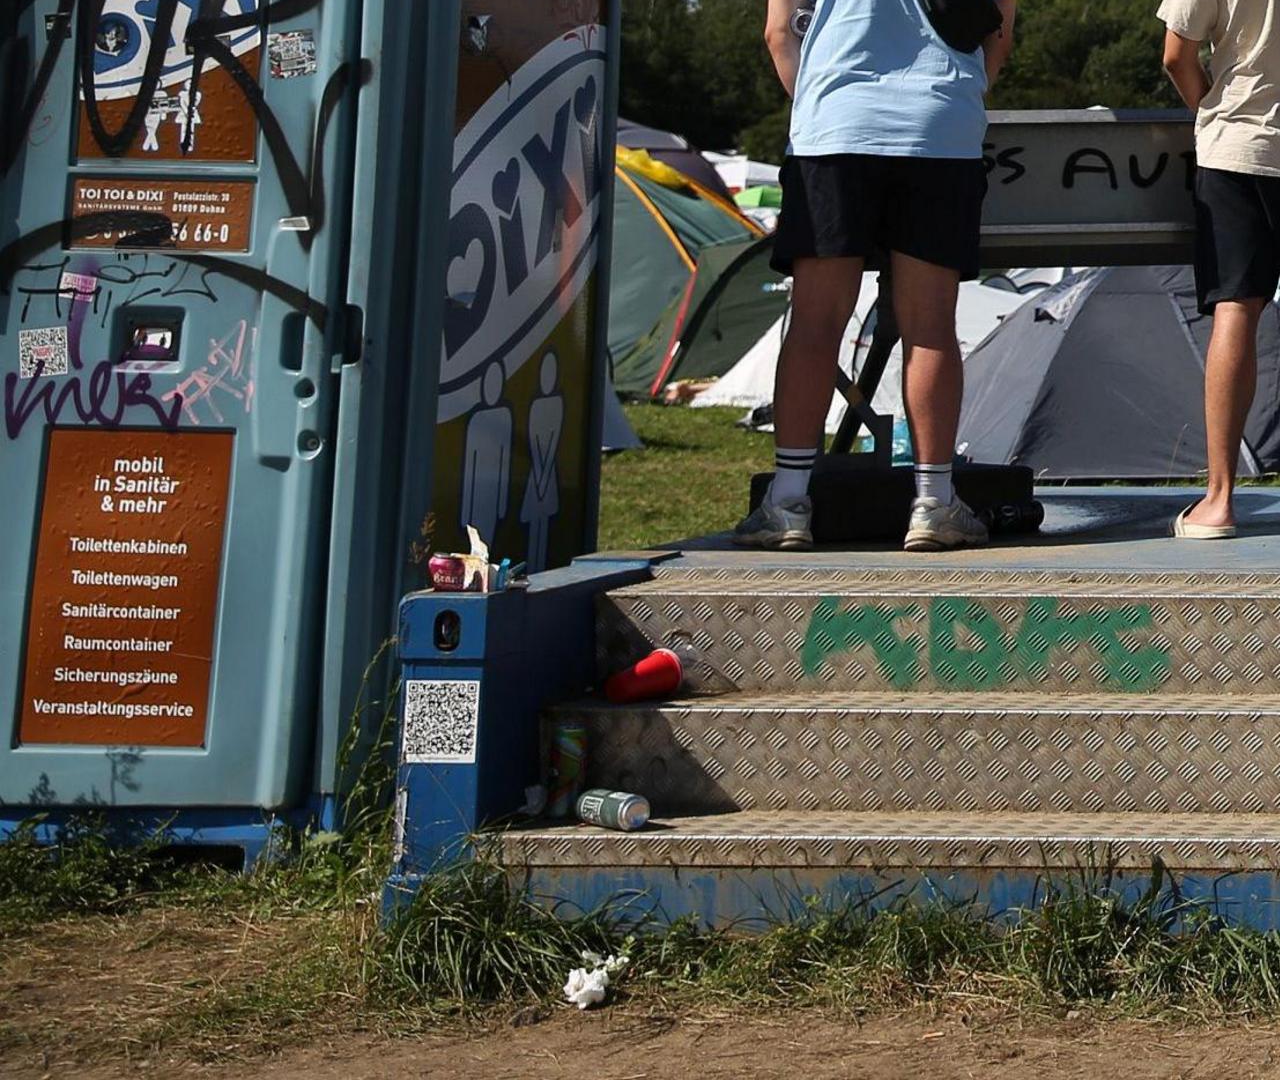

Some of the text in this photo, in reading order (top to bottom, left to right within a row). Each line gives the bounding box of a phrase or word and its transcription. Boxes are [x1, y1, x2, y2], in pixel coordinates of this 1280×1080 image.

[80, 188, 164, 202] TOI TOI & DIXI
[194, 223, 230, 243] 66-0
[114, 456, 164, 473] mobil
[94, 475, 180, 494] in Sanitär
[100, 495, 168, 513] & mehr
[69, 537, 188, 555] Toilettenkabinen
[72, 570, 178, 589] Toilettenwagen
[62, 602, 181, 620] Sanitärcontainer
[64, 635, 173, 652] Raumcontainer
[54, 667, 178, 686] Sicherungszäune
[33, 699, 194, 719] Veranstaltungsservice
